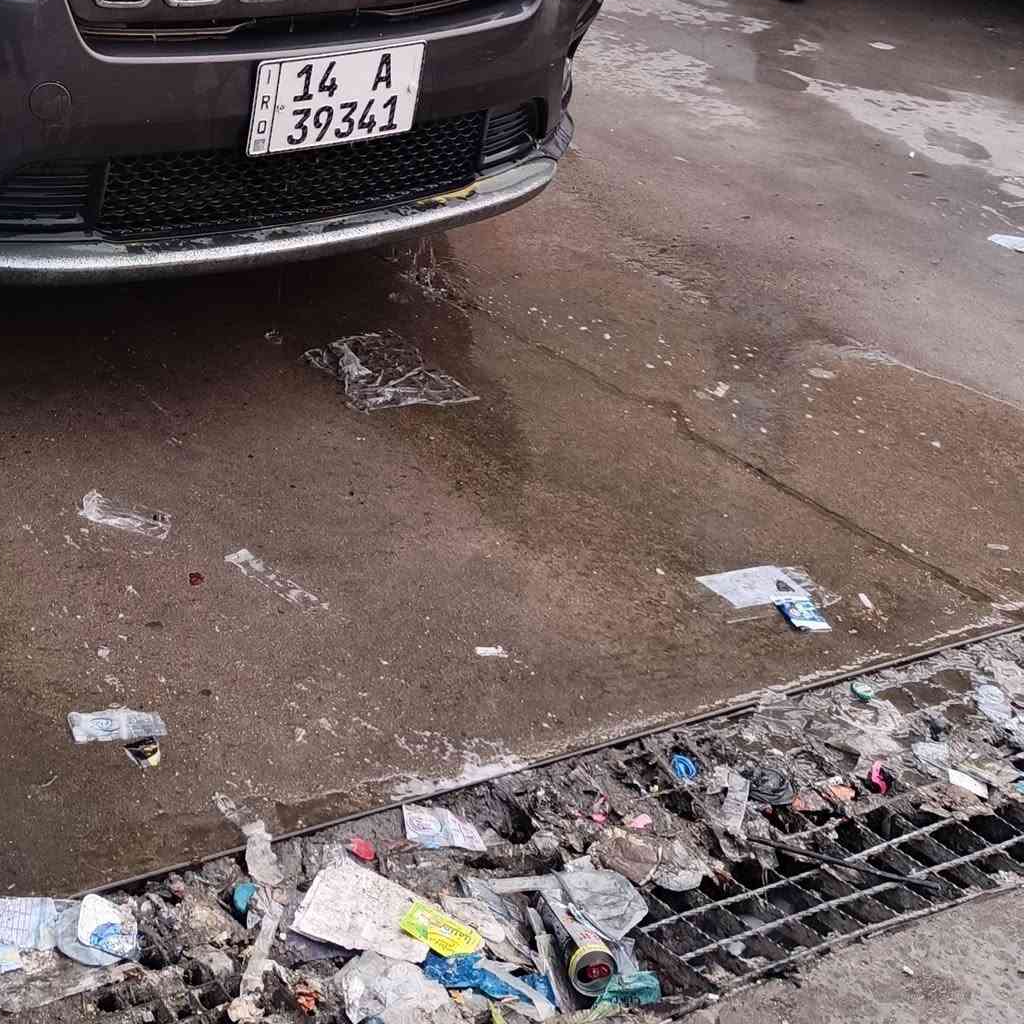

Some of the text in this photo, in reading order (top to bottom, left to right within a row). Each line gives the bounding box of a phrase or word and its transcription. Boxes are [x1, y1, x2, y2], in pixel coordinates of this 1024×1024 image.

[292, 53, 392, 102] 14 A
[286, 94, 398, 145] 39341
